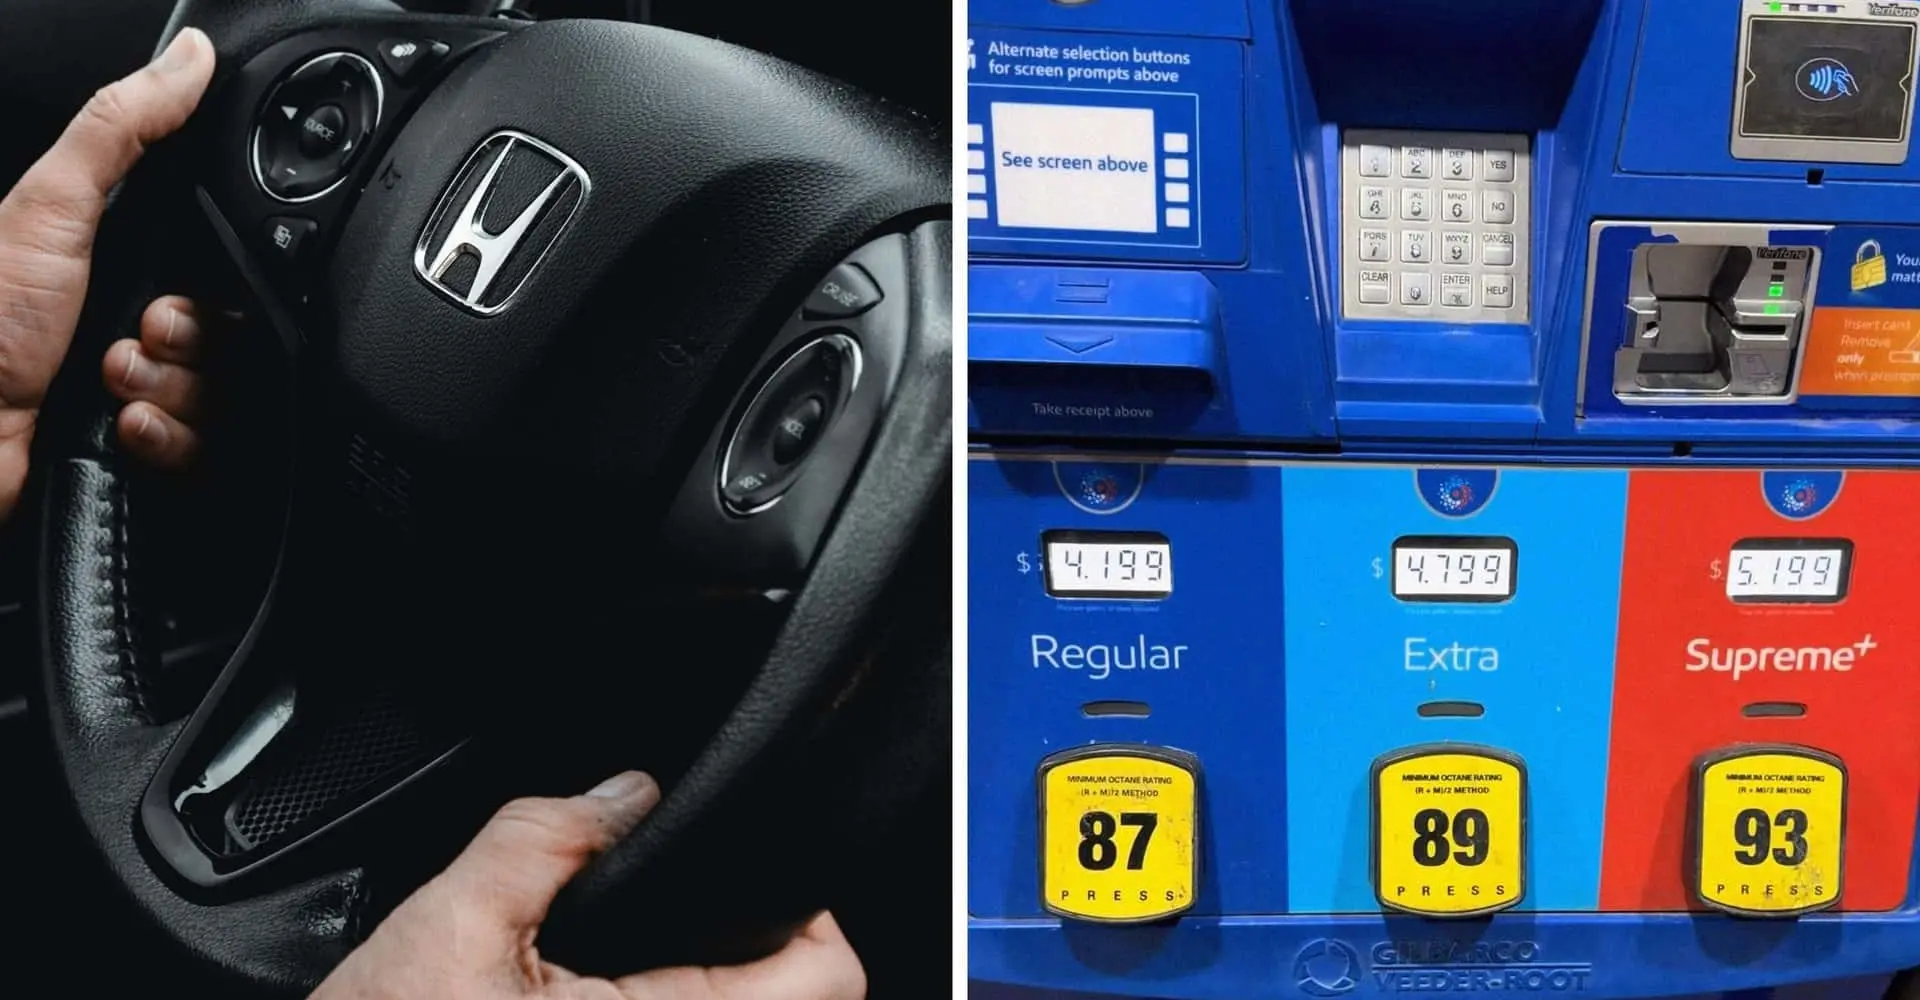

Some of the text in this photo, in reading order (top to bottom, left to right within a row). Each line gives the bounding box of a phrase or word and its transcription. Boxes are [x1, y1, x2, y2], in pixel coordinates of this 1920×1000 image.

[1868, 3, 1919, 17] Verifone
[988, 41, 1191, 66] Alternate selection buttons
[988, 59, 1180, 84] for screen prompts above
[1002, 152, 1149, 173] See screen above
[1410, 160, 1422, 174] 2
[1452, 161, 1463, 176] 3
[1489, 160, 1507, 170] YES
[1452, 203, 1463, 218] 6
[1491, 202, 1506, 211] NO
[1408, 233, 1425, 241] TUV
[1483, 234, 1513, 244] CANCEL
[1410, 243, 1422, 258] 8
[1451, 245, 1463, 260] 9
[1896, 252, 1920, 267] You
[1361, 271, 1389, 282] CLEAR
[1443, 275, 1471, 285] ENTER
[1485, 286, 1509, 295] HELP
[1844, 318, 1881, 331] Insert
[1840, 333, 1891, 348] Remove
[1837, 352, 1865, 367] only
[1032, 402, 1154, 419] Take receipt above
[1016, 550, 1163, 581] $ 4.199
[1371, 554, 1501, 585] $ 4.799
[1709, 555, 1832, 586] $ 5.199
[1031, 633, 1189, 680] Regular
[1404, 637, 1499, 672] Extra
[1067, 775, 1173, 785] MINIMUM OCTANE RATING
[1402, 774, 1503, 782] MINIMUM OCTANE RATING
[1764, 774, 1794, 782] OCTANE
[1796, 775, 1825, 783] RATING
[1121, 788, 1159, 797] METHOD
[1454, 786, 1490, 794] METHOD
[1078, 810, 1158, 871] 87
[1412, 808, 1490, 867] 89
[1734, 808, 1809, 867] 93
[1371, 940, 1541, 964] GILBARCO
[1371, 968, 1592, 993] VEEDER-ROOT
